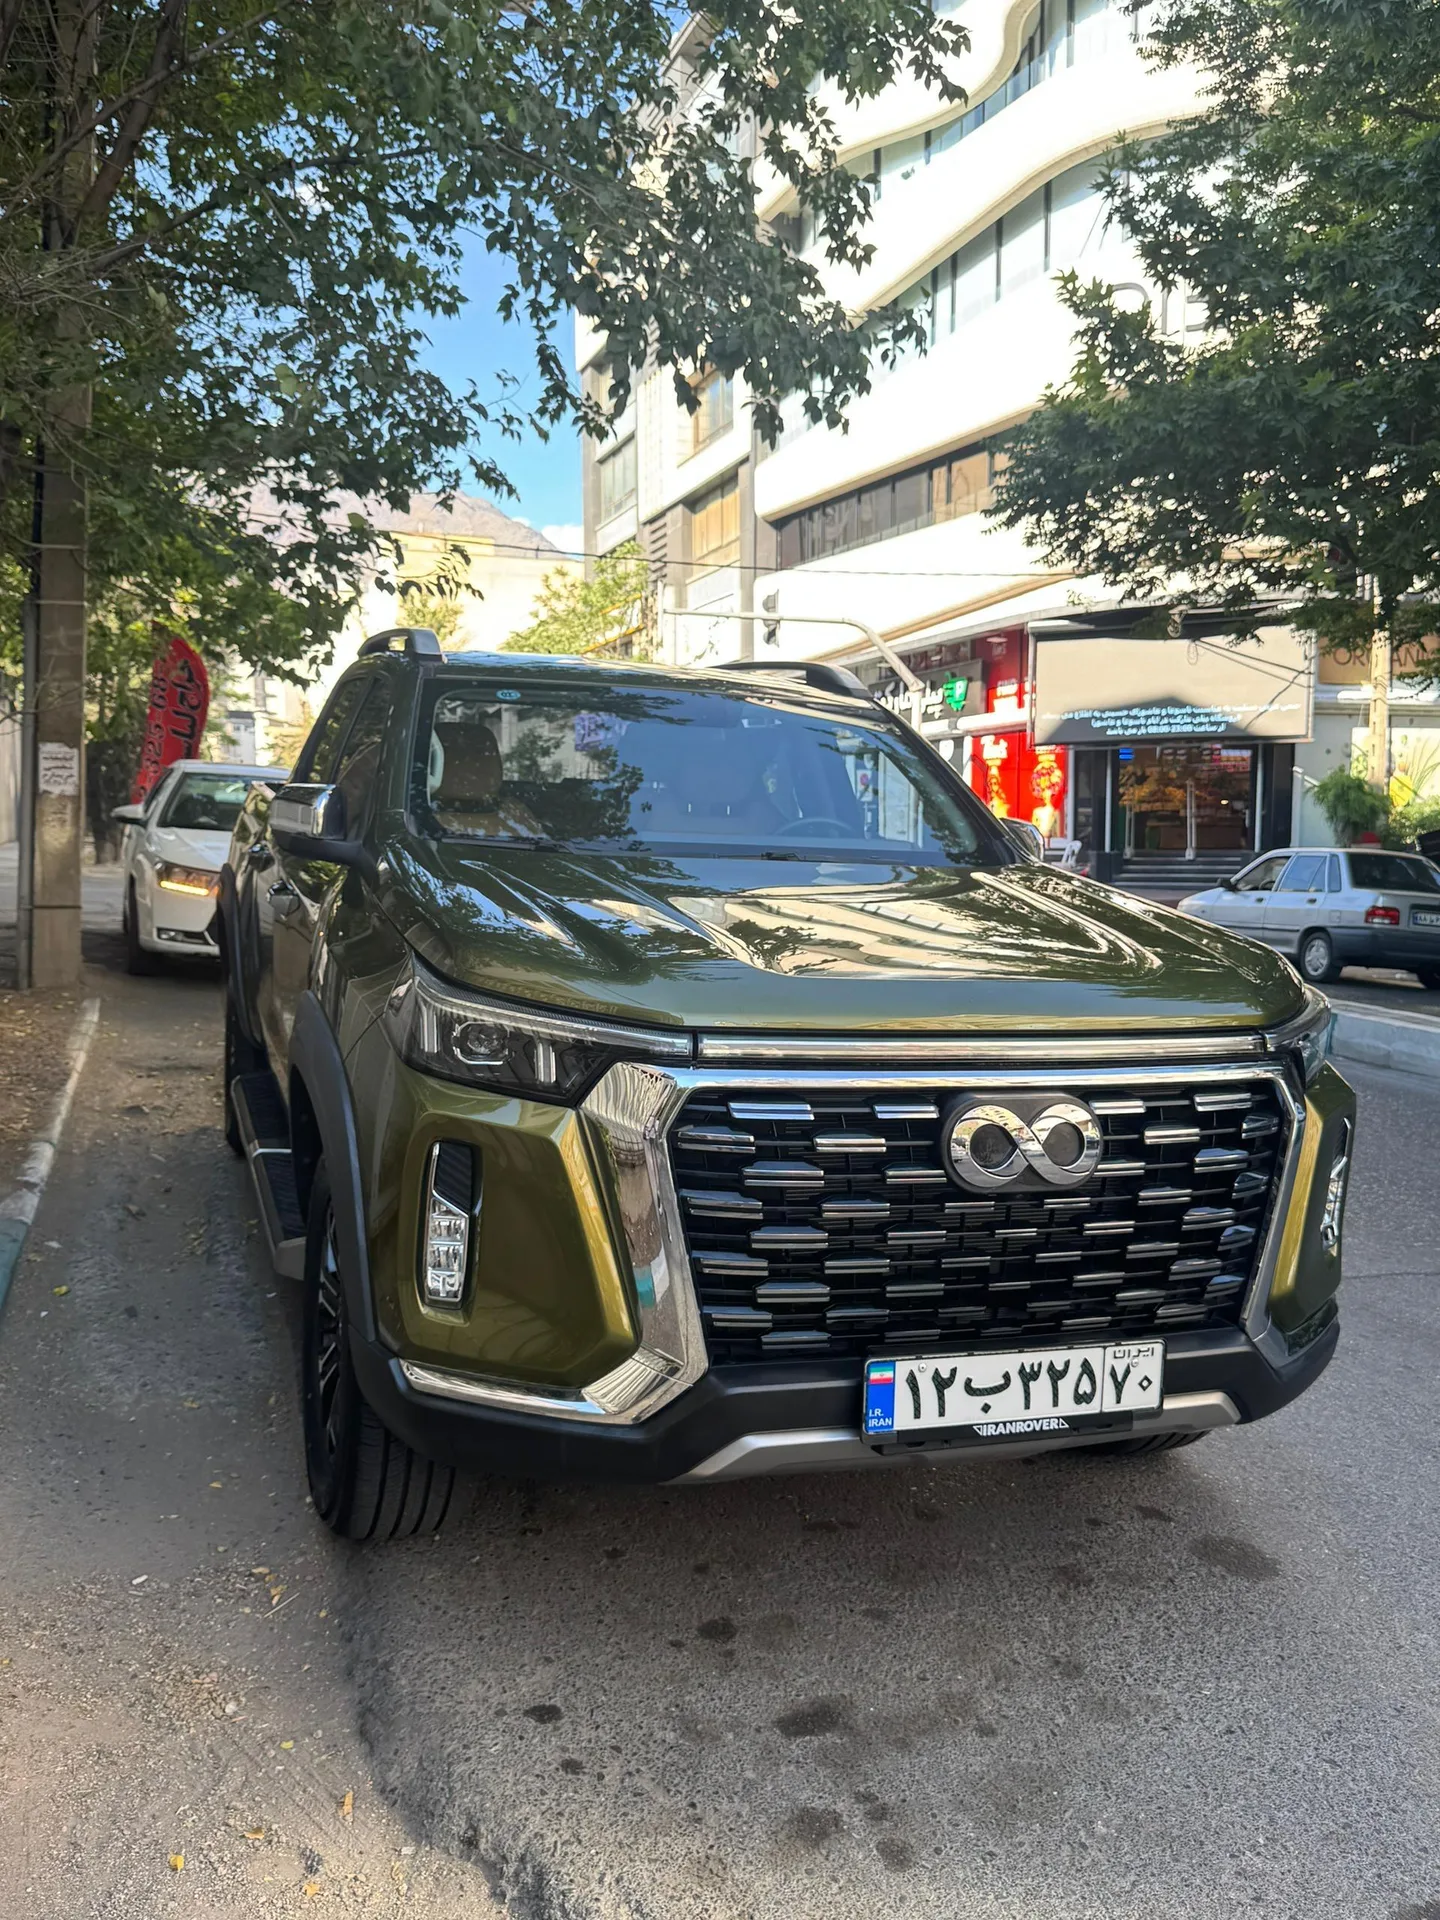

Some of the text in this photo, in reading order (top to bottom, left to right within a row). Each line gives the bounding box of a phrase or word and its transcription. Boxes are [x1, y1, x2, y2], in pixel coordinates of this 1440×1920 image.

[1113, 1347, 1155, 1359] ایران
[1110, 1363, 1153, 1404] ۷۰
[869, 1408, 884, 1417] I.R.
[868, 1417, 892, 1428] IRAN
[982, 1418, 1061, 1437] IRANROVER
